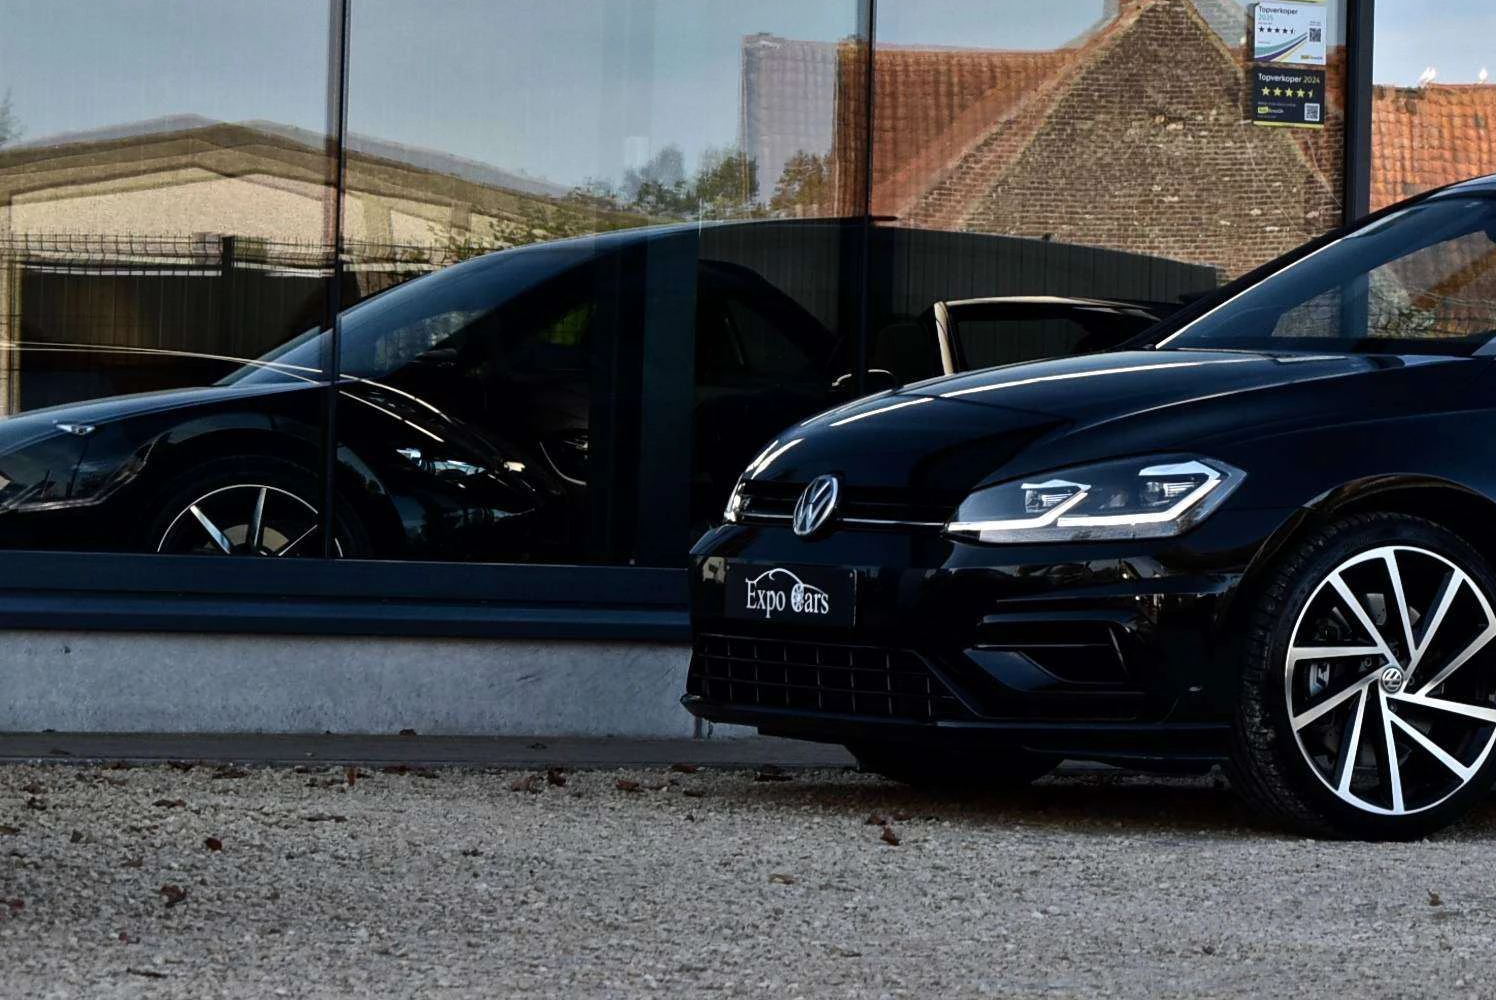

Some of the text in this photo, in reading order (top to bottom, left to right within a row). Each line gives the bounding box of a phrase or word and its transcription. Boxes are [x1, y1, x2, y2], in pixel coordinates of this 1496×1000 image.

[1258, 5, 1298, 15] Topverkoper
[1257, 72, 1302, 84] Topverkoper
[745, 577, 830, 619] Expo Cars
